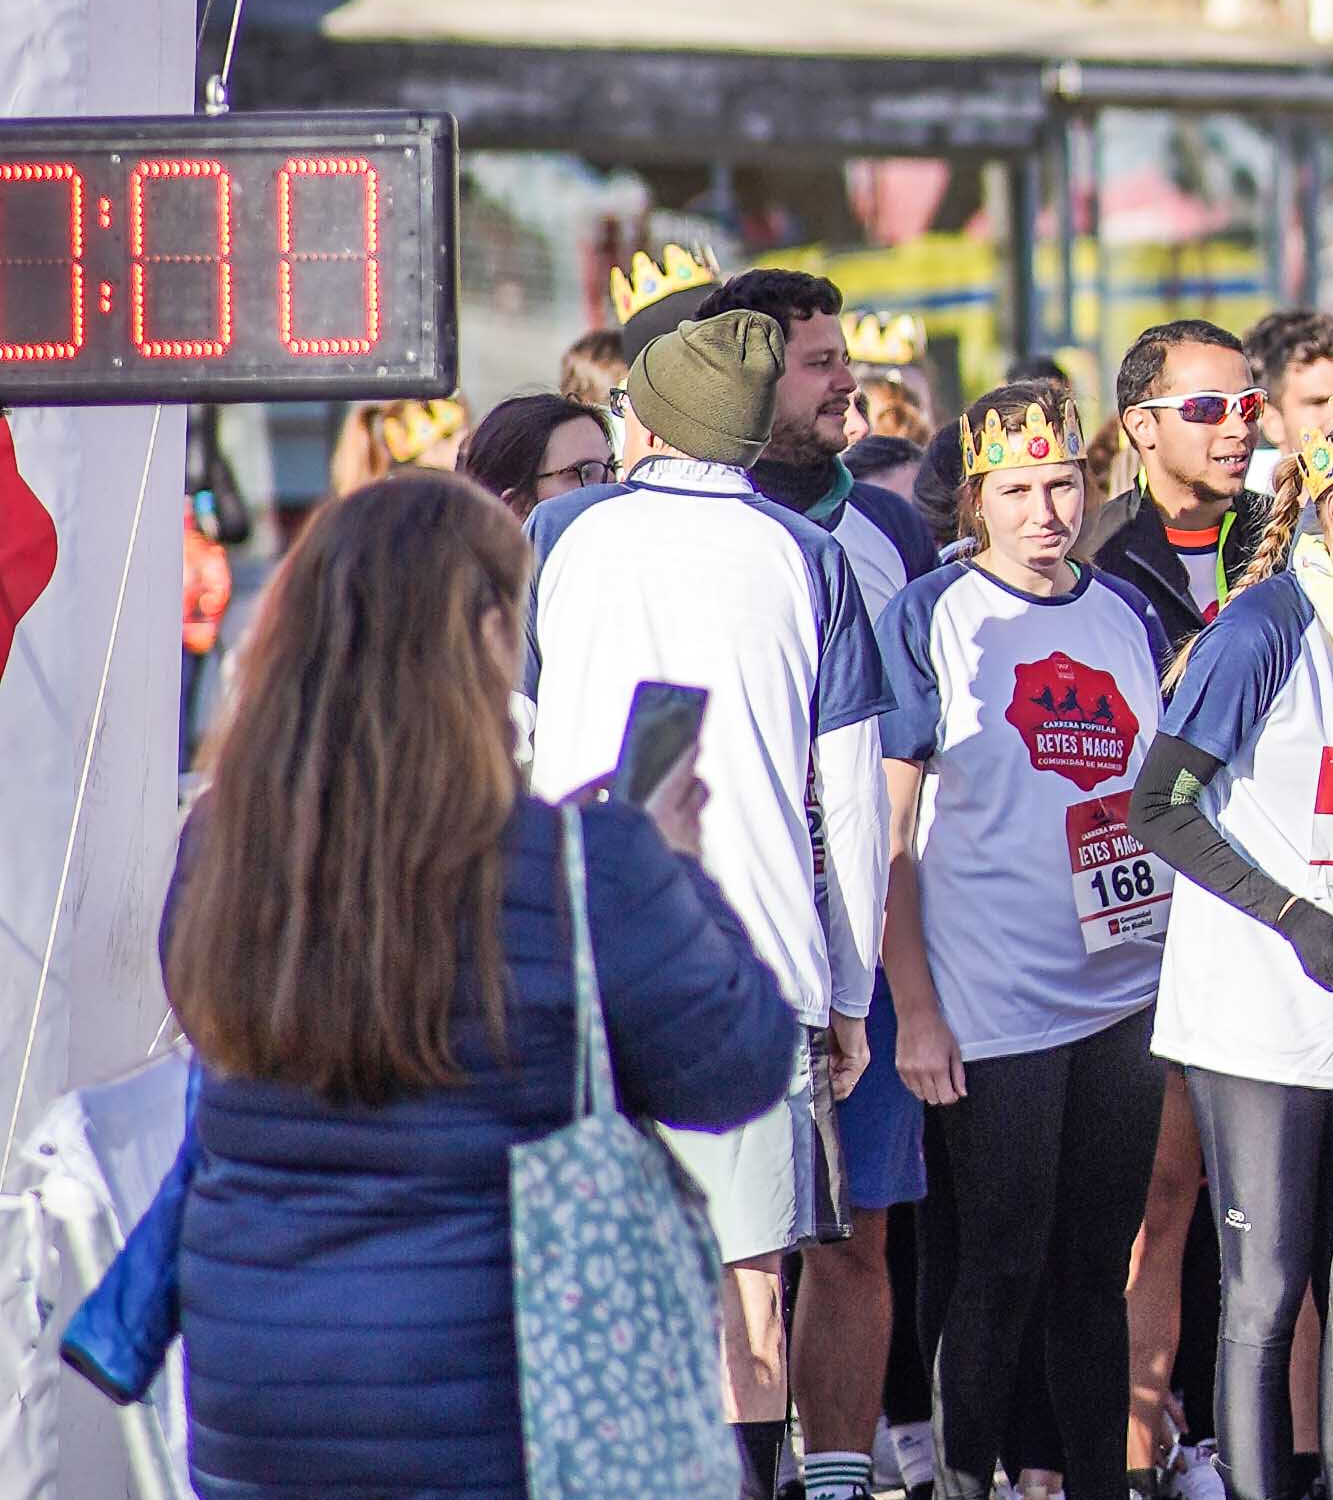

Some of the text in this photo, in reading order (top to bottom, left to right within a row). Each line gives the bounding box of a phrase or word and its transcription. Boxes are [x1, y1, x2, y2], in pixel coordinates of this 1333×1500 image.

[1036, 733, 1124, 759] REYES MAGOS
[1091, 859, 1155, 908] 168
